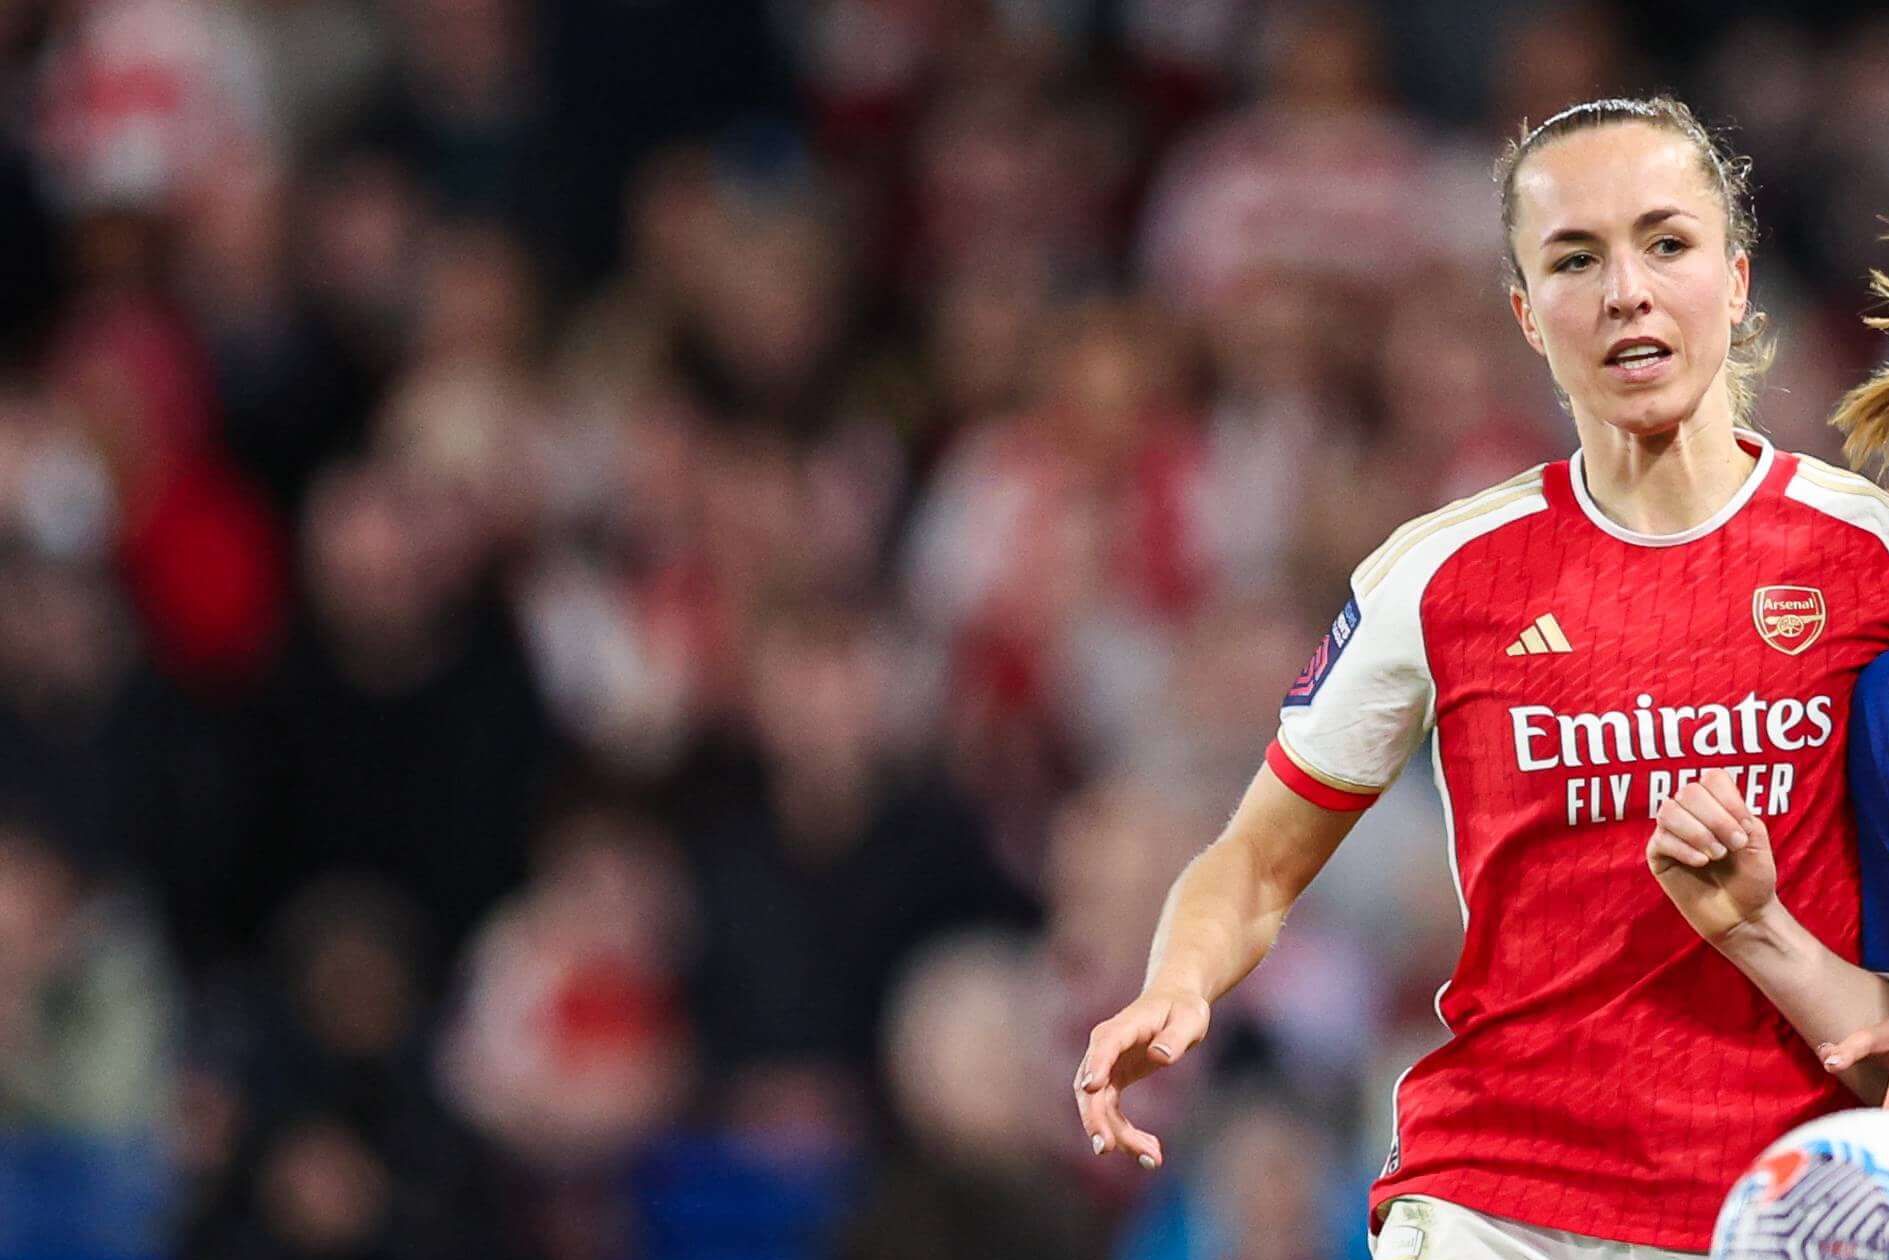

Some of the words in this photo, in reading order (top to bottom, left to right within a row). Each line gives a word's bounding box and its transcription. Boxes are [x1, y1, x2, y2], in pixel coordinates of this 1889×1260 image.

[1763, 597, 1814, 610] Arsenal
[1508, 691, 1832, 772] Emirates
[1567, 773, 1632, 826] FLY
[1648, 762, 1794, 820] BER
